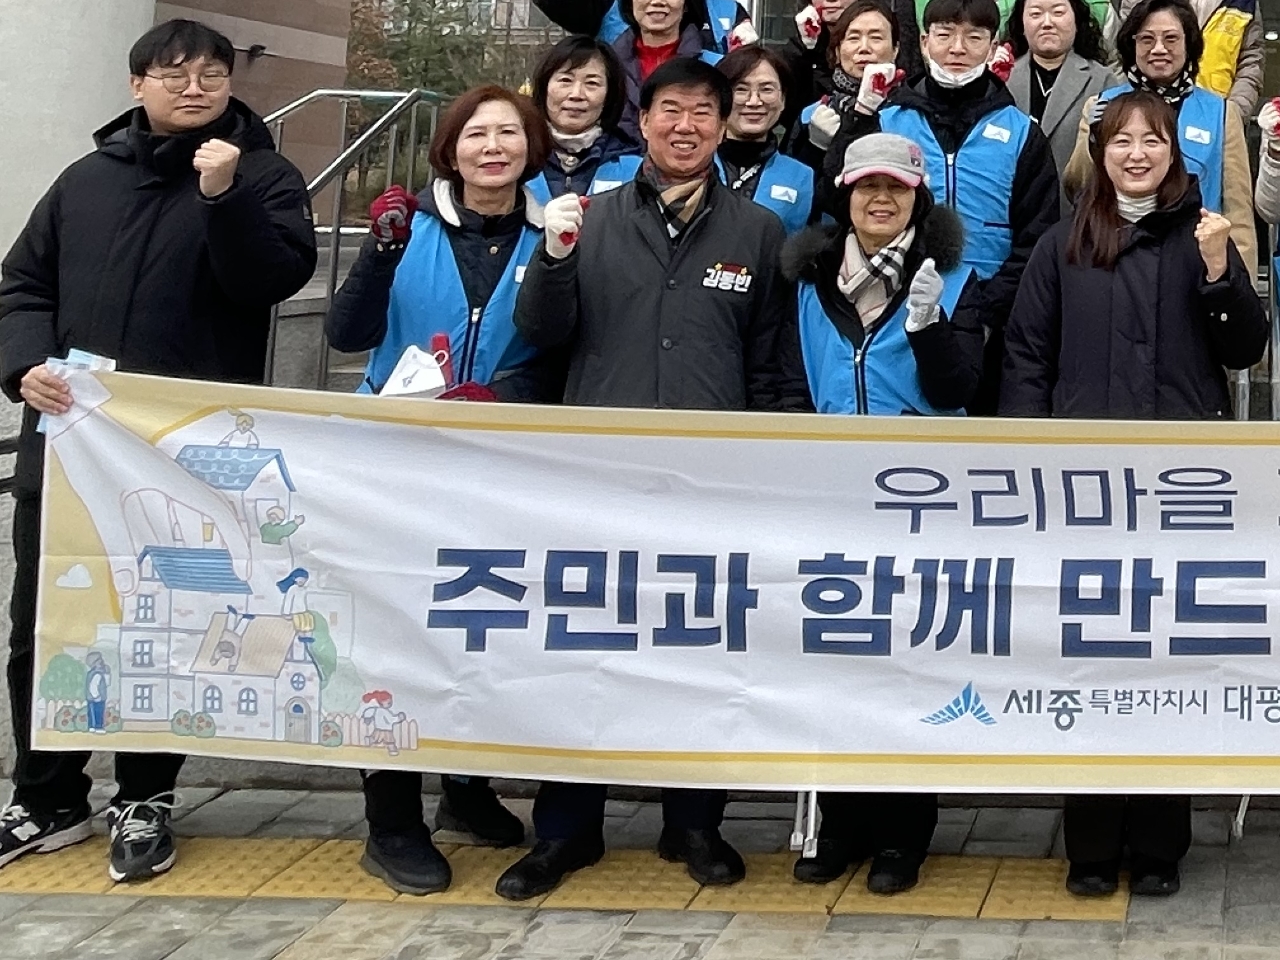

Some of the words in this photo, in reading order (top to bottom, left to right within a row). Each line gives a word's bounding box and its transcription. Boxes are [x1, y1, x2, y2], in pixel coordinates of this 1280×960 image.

[875, 467, 1238, 533] 우리마을
[427, 548, 759, 652] 주민과
[797, 552, 1015, 656] 함께
